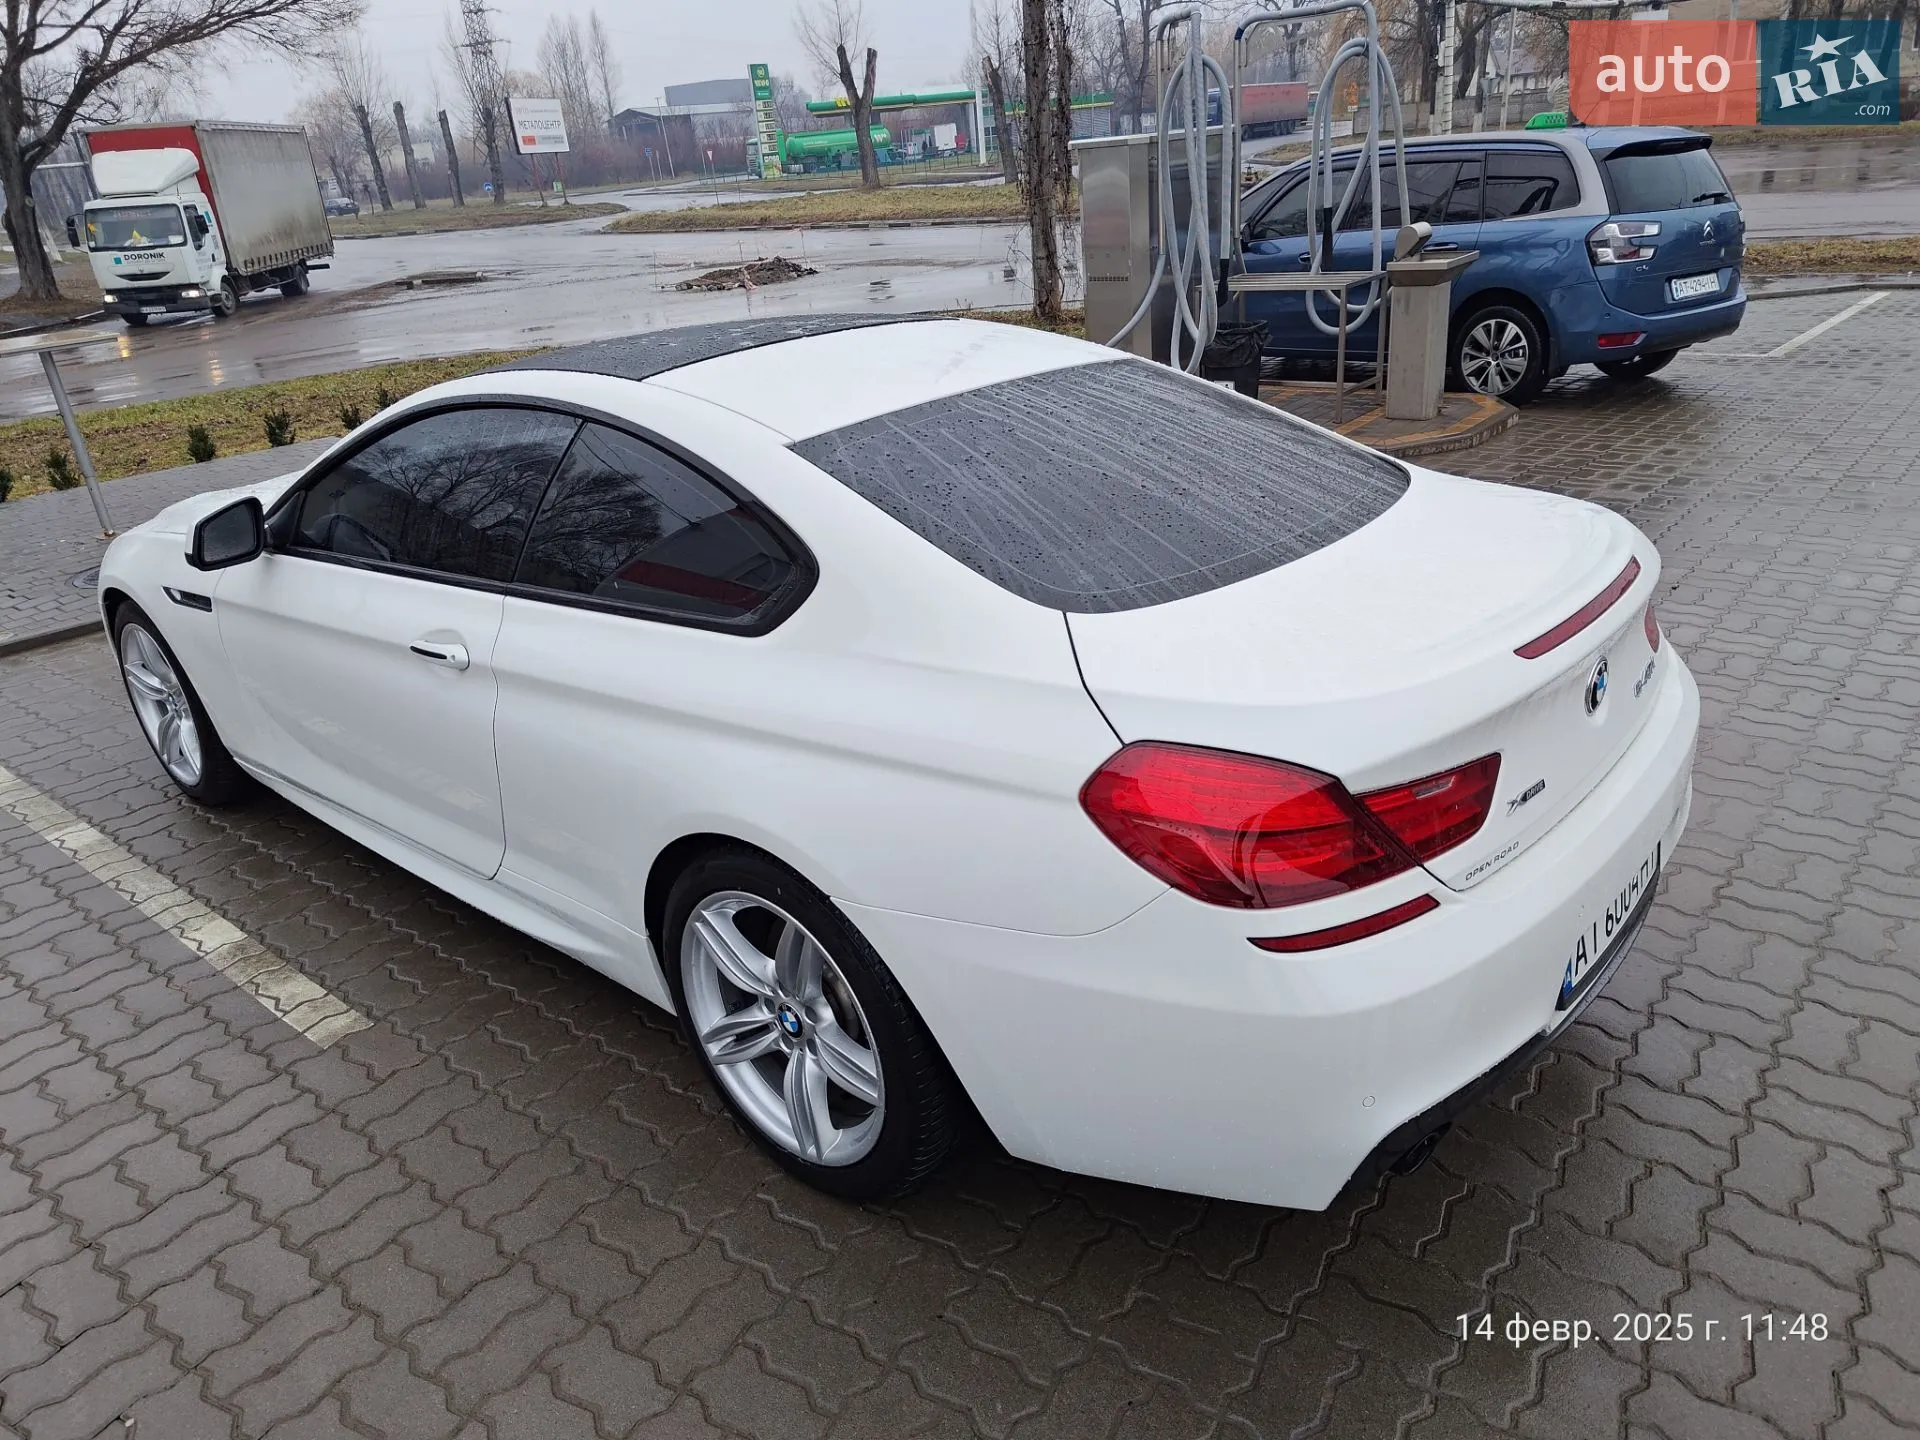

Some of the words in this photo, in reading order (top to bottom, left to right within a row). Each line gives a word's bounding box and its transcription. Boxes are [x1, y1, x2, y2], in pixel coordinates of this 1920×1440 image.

[123, 252, 166, 261] DORONIK
[1465, 859, 1493, 881] OPEN
[1493, 841, 1520, 864] ROAD
